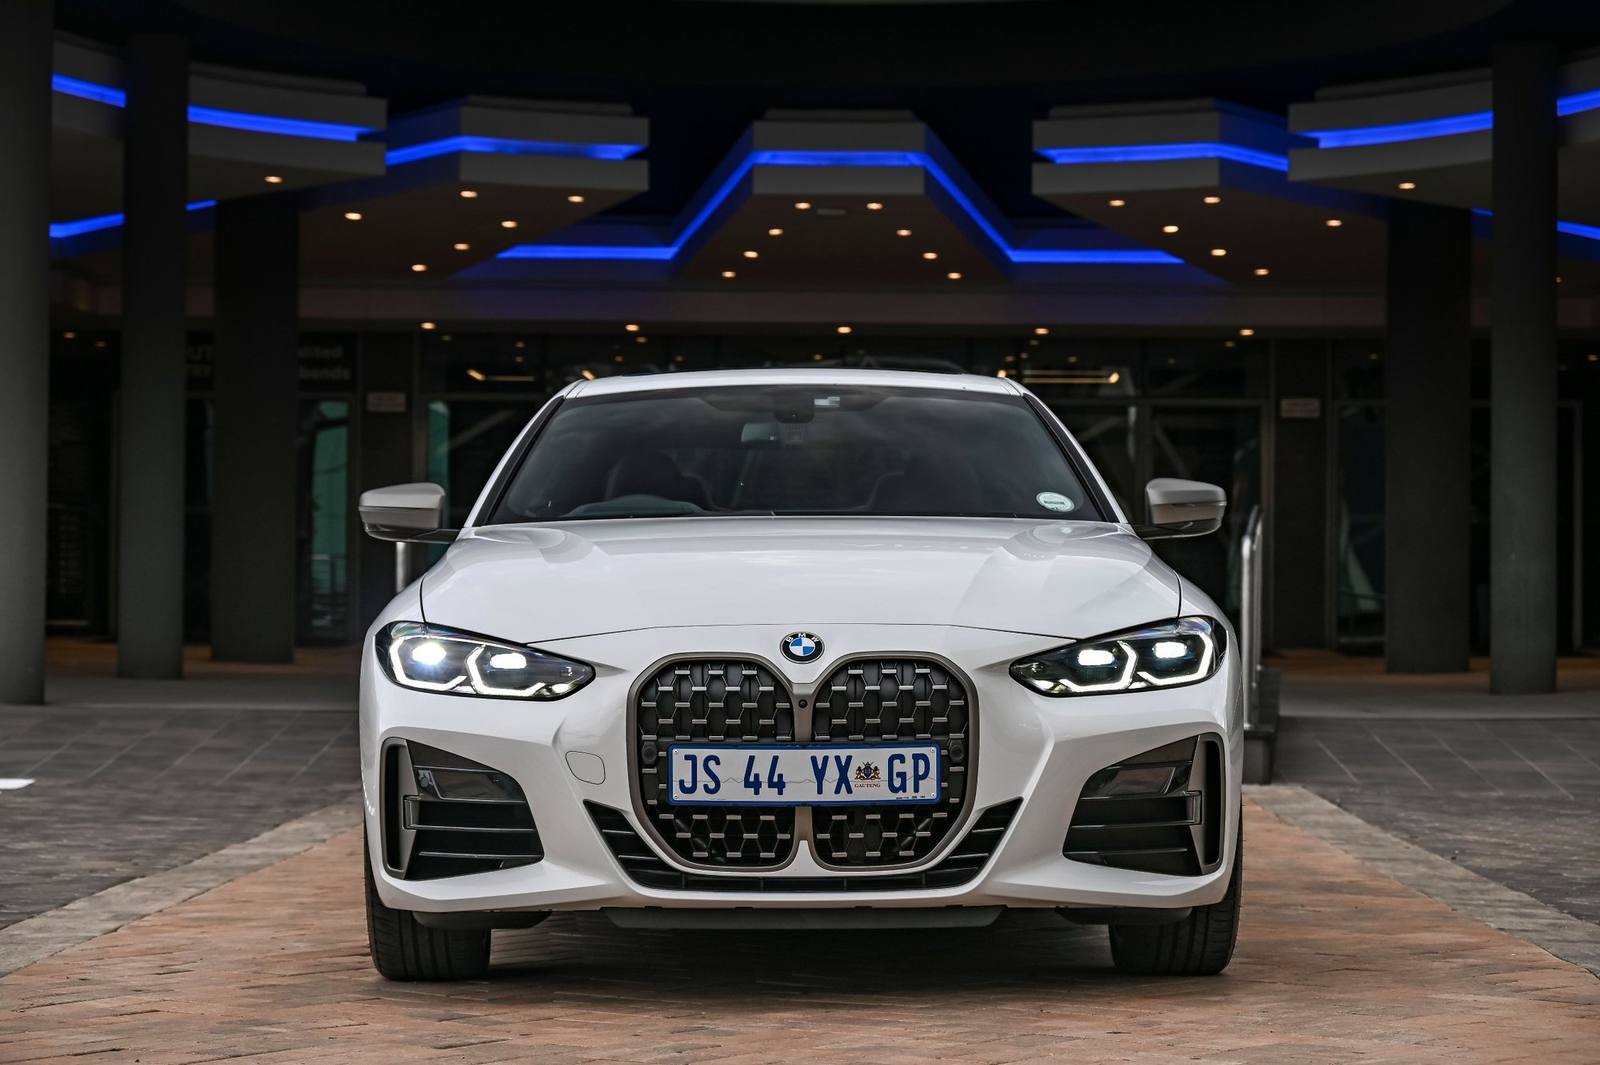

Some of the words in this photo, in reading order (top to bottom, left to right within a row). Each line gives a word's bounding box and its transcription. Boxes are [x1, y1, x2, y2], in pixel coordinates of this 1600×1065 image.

[786, 632, 819, 643] BMW
[678, 754, 721, 795] JS
[743, 755, 786, 795] 44
[810, 754, 853, 795] YX
[887, 753, 931, 795] GP
